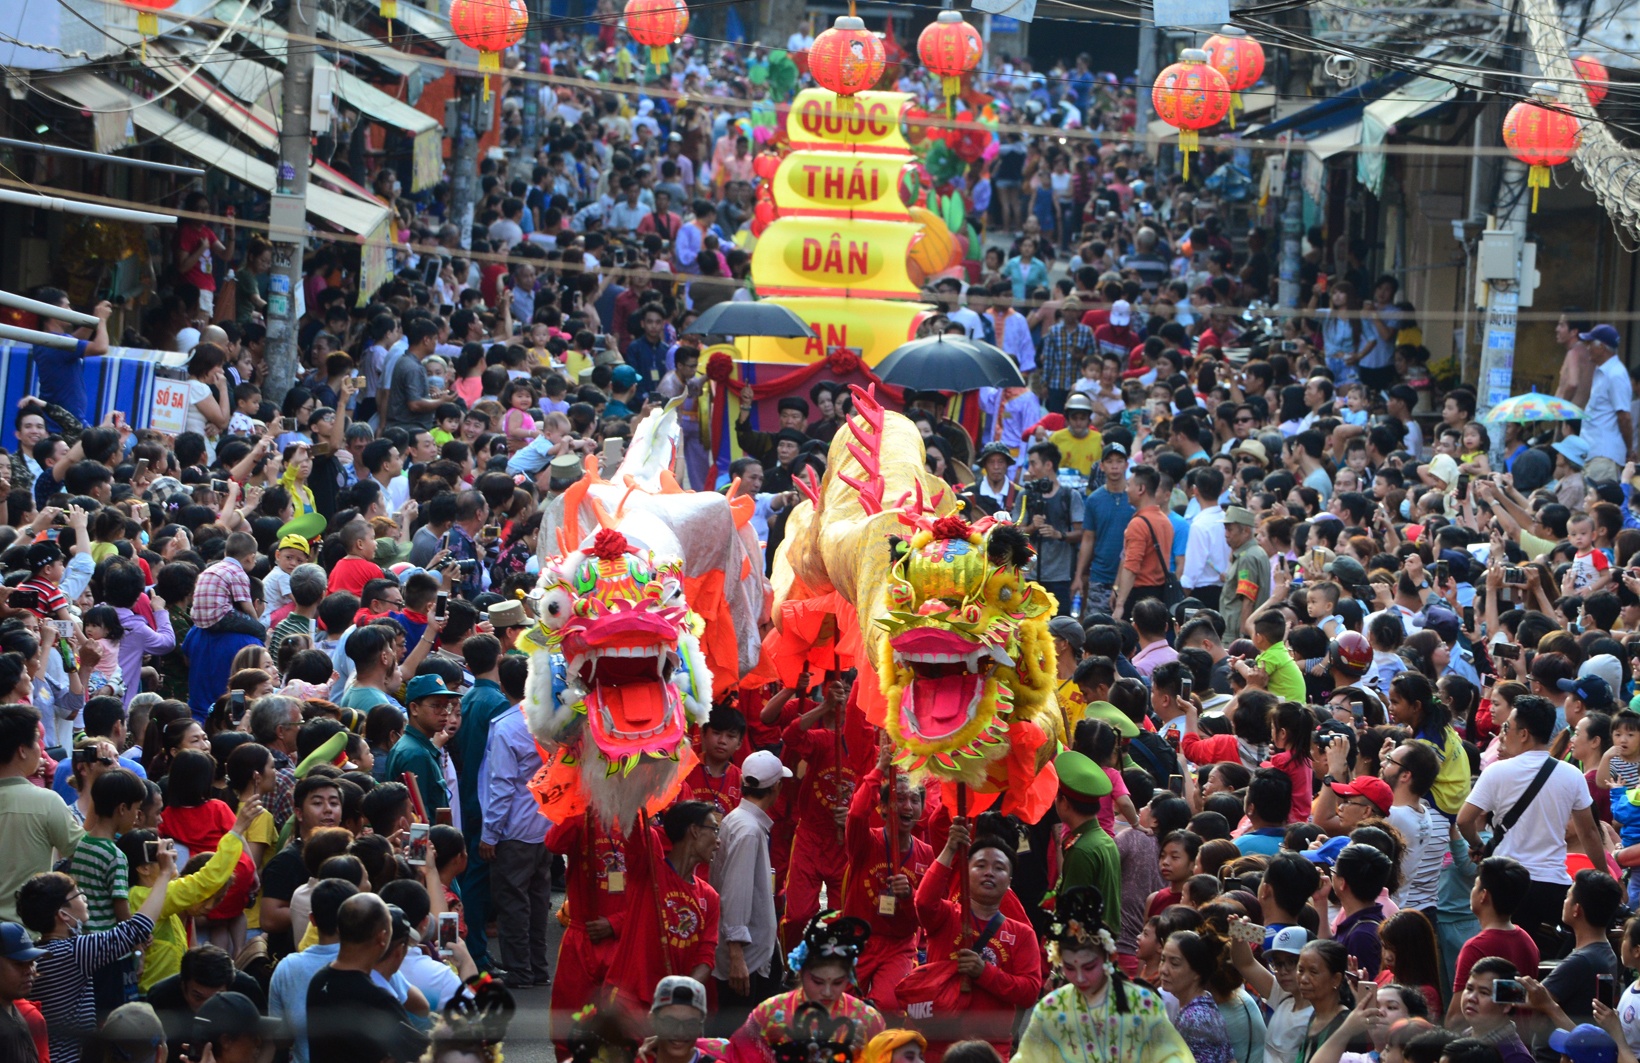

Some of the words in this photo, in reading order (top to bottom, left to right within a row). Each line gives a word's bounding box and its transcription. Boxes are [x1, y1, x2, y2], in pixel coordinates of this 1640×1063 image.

[801, 96, 888, 138] QUỐC
[803, 160, 879, 201] THÁI
[802, 232, 869, 275] DÂN
[804, 321, 847, 356] AN
[156, 385, 172, 407] SỐ
[171, 392, 185, 409] 5A
[907, 1000, 934, 1020] NIKE
